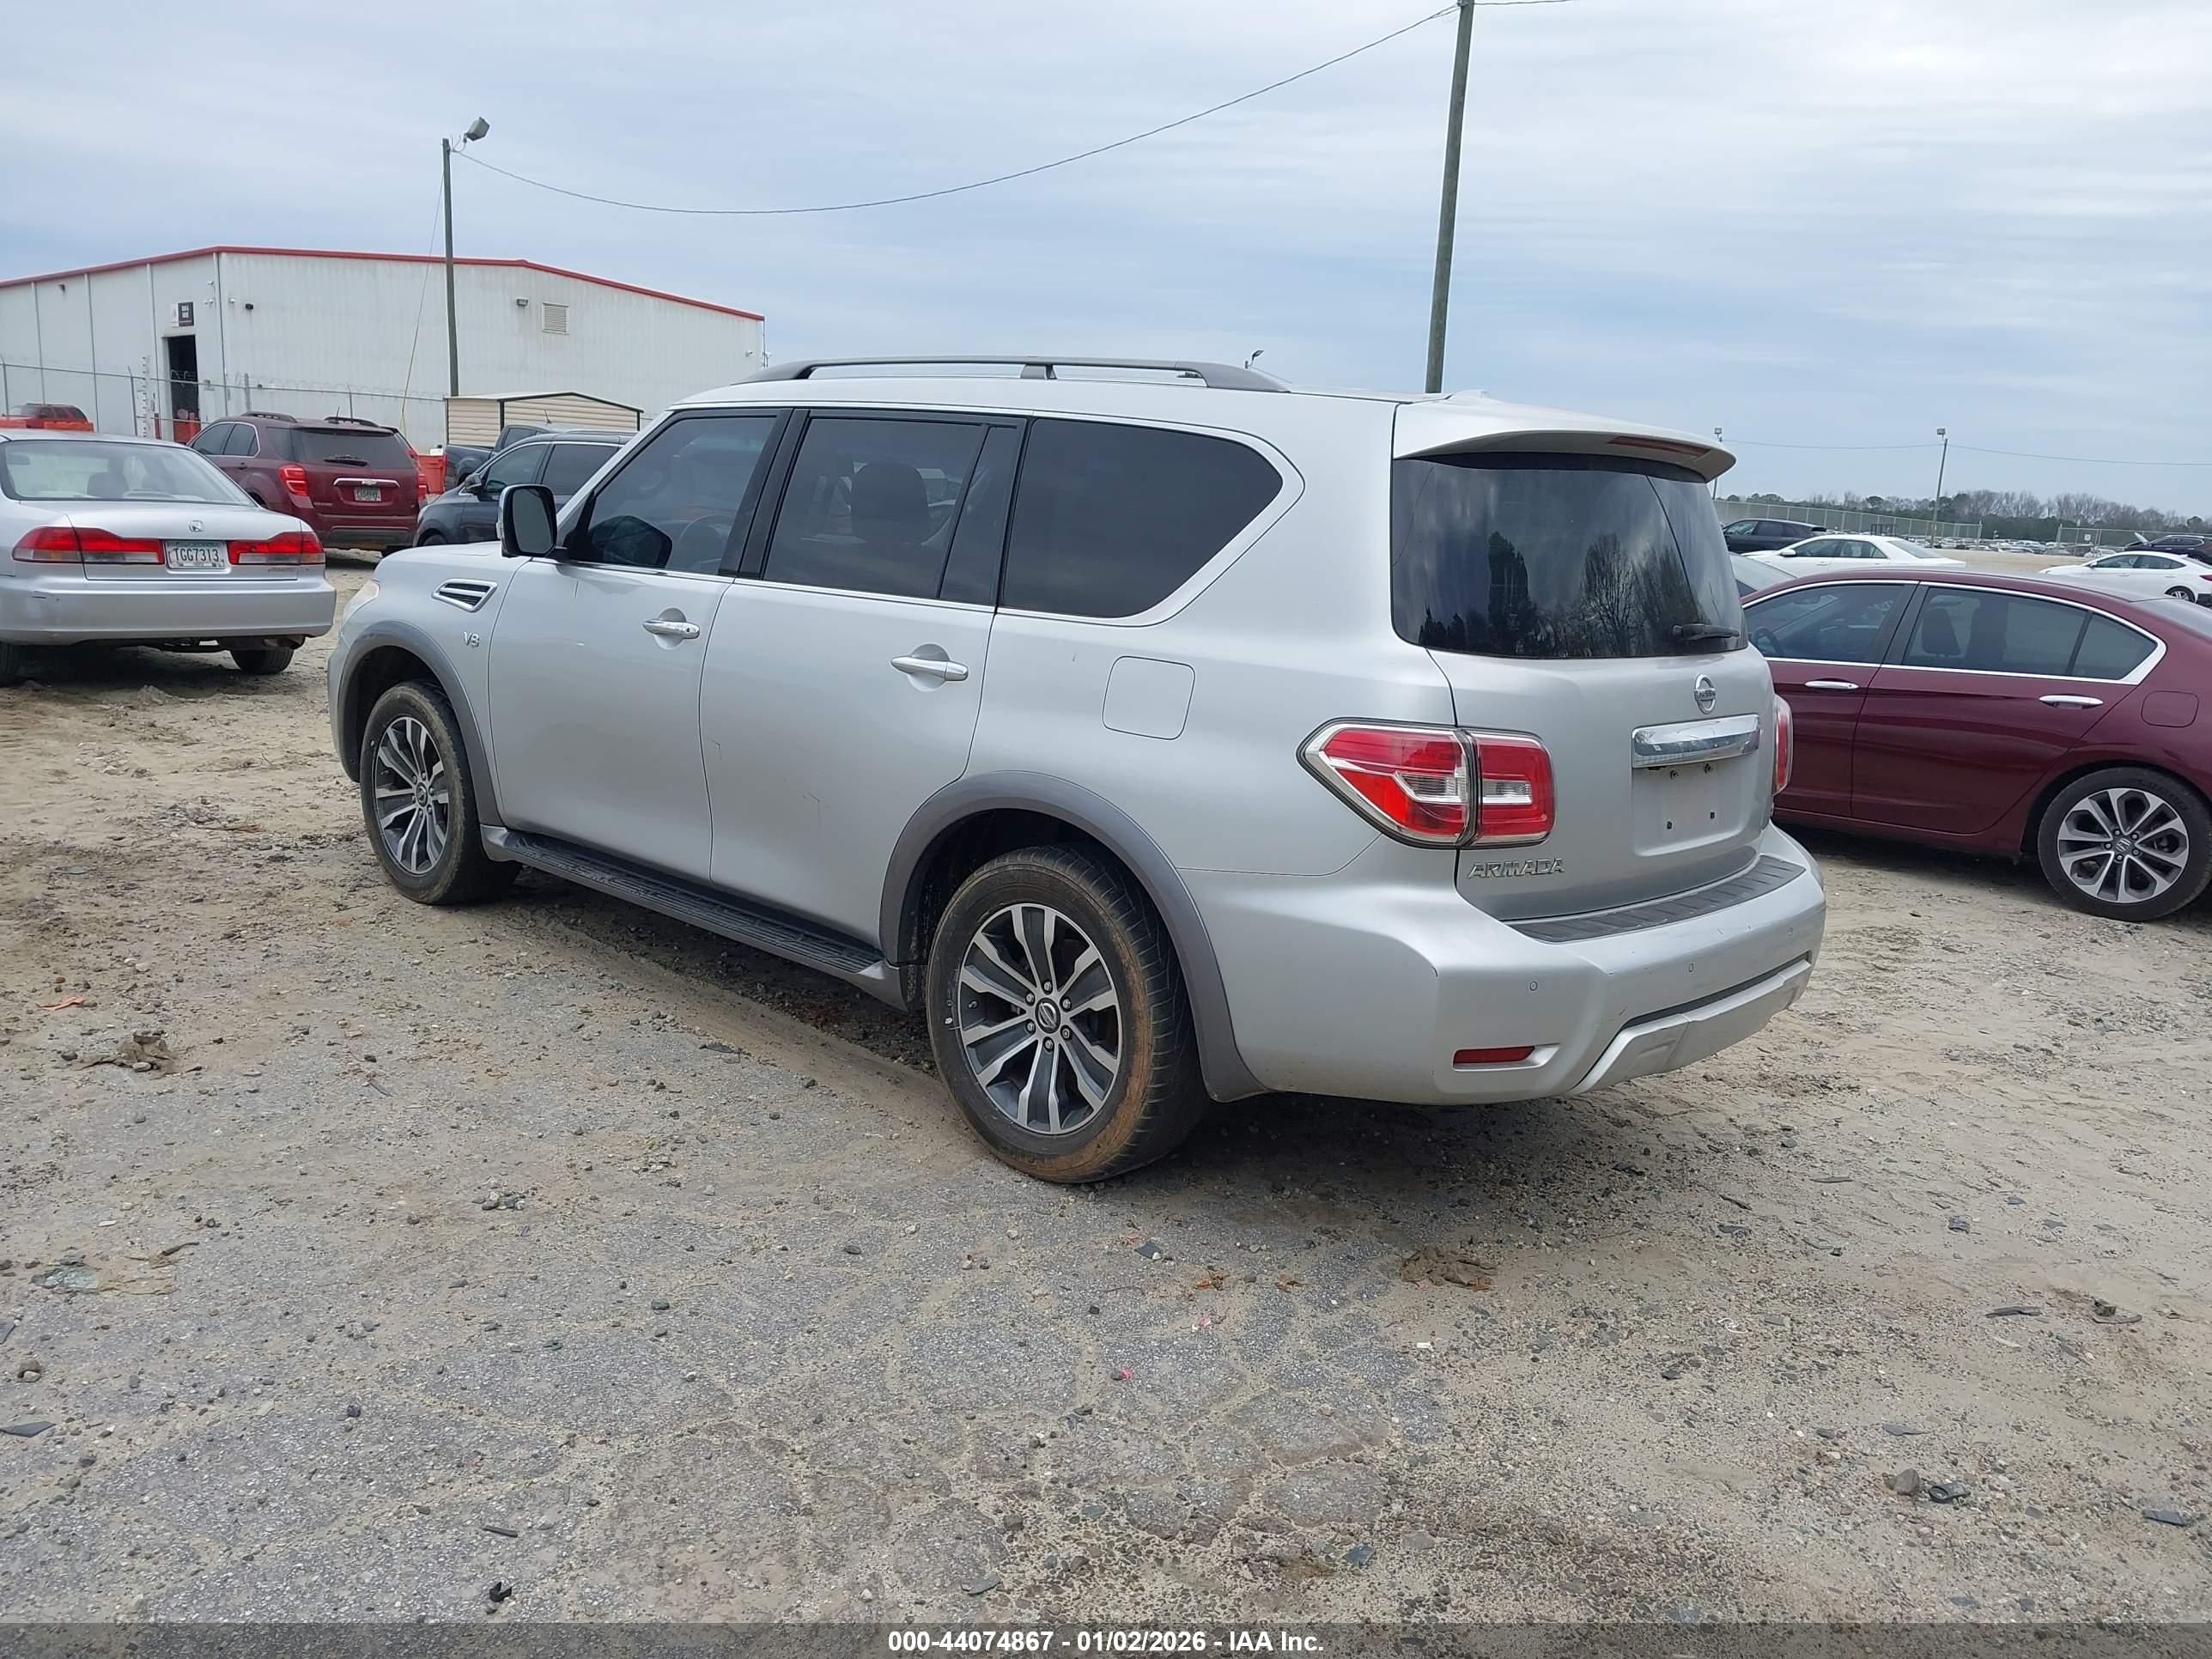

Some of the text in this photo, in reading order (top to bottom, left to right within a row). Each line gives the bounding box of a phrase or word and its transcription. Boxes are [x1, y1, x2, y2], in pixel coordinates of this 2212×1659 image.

[173, 548, 220, 562] TGG7313
[464, 631, 480, 647] V8
[1467, 858, 1565, 878] ARMADA
